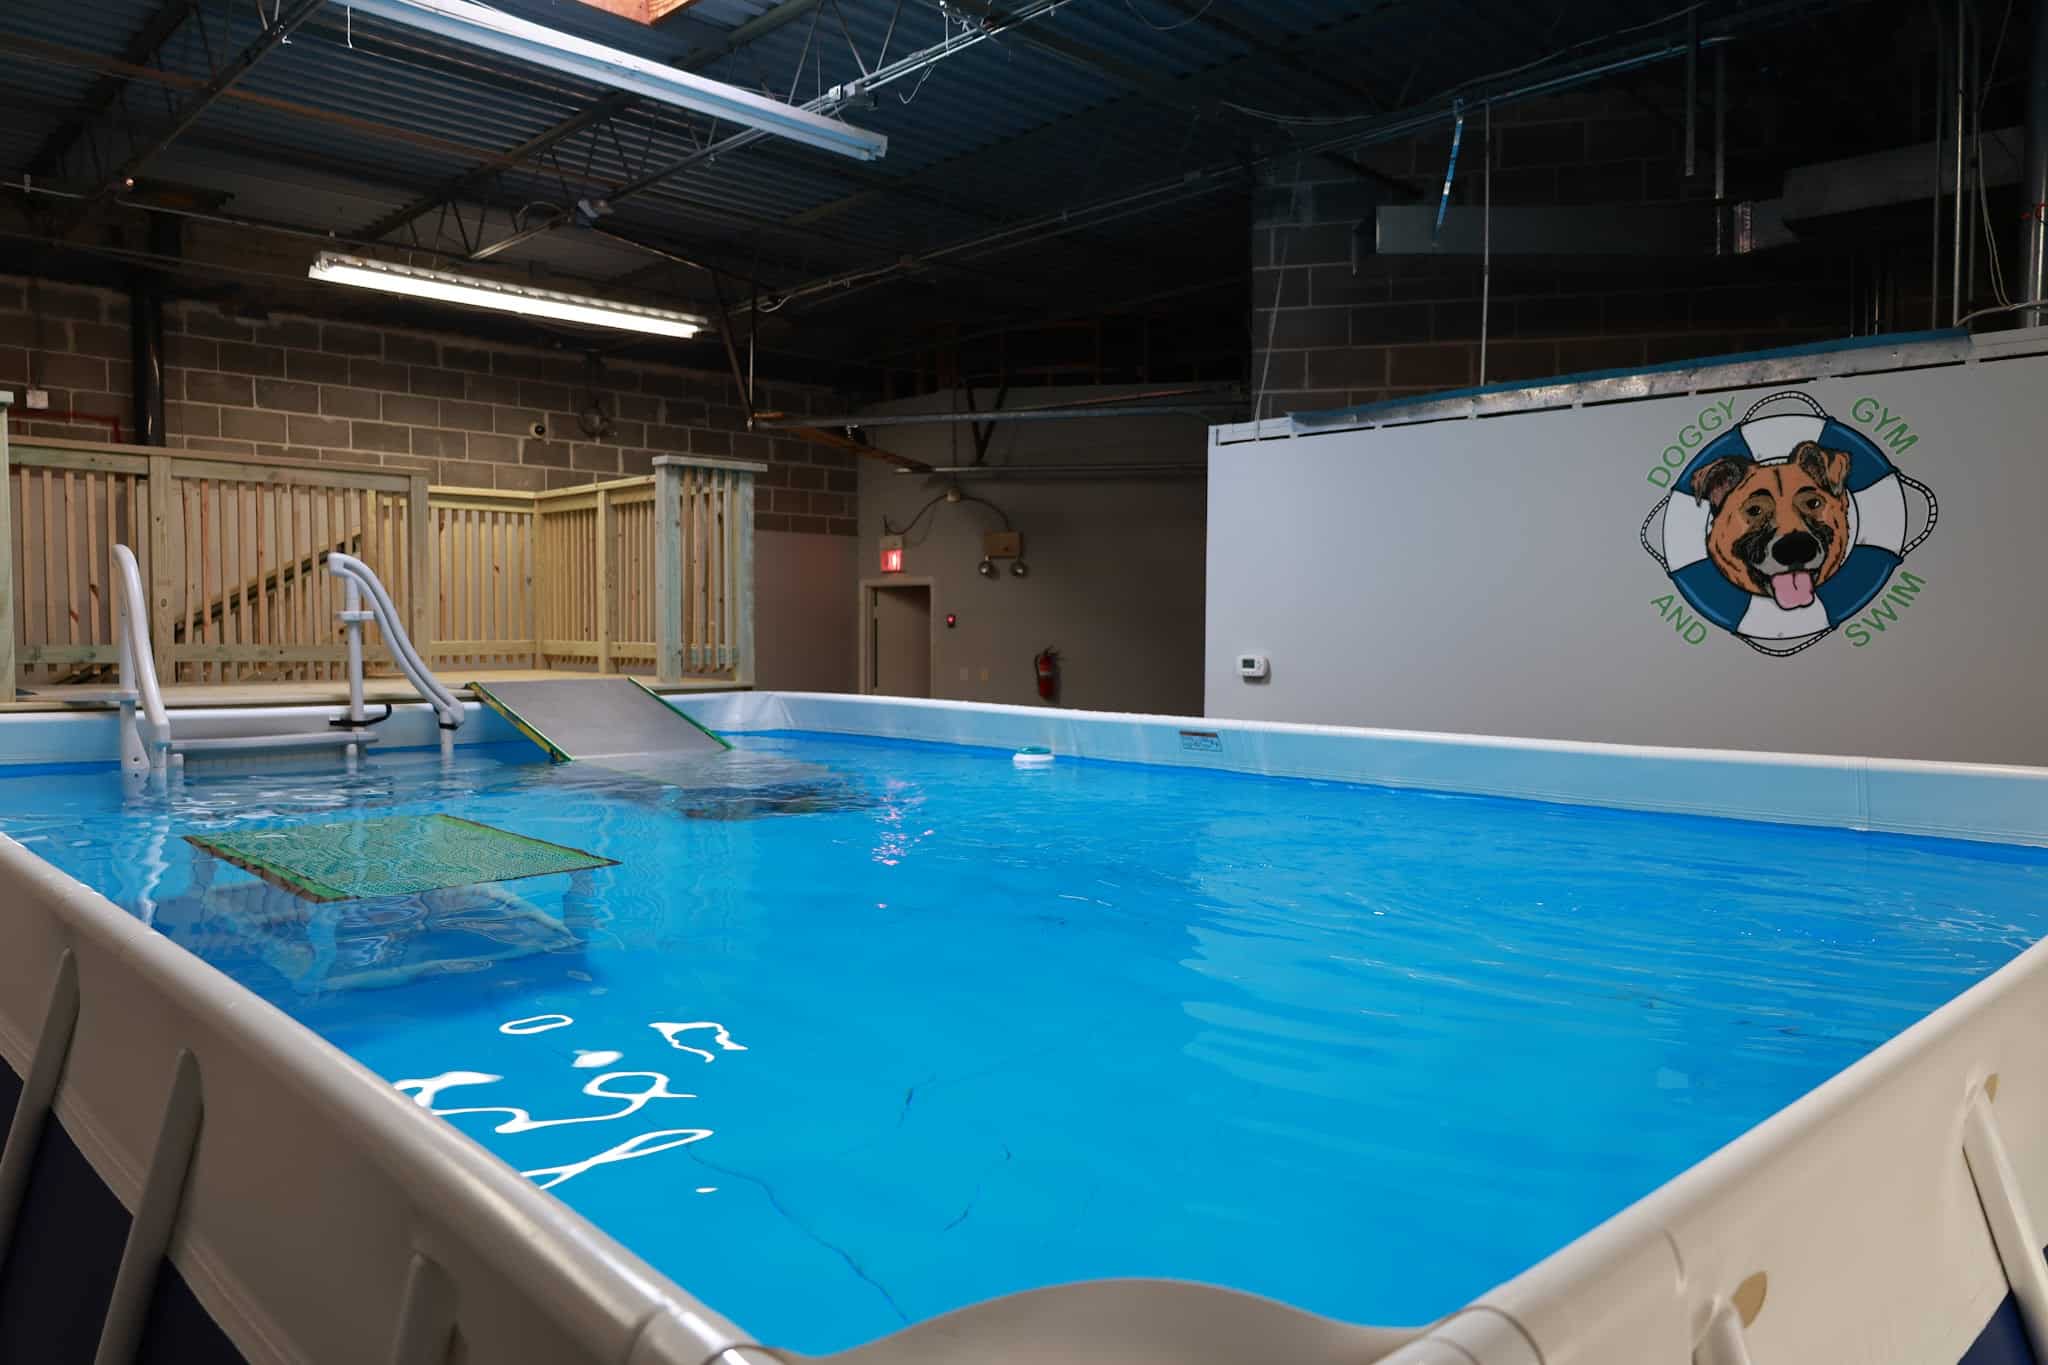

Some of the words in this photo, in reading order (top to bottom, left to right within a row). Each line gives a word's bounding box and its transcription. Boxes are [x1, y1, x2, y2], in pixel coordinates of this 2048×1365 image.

[1647, 396, 1737, 488] DOGGY
[1851, 397, 1920, 455] GYM
[1650, 593, 1708, 646] AND
[1844, 570, 1927, 648] SWIM
